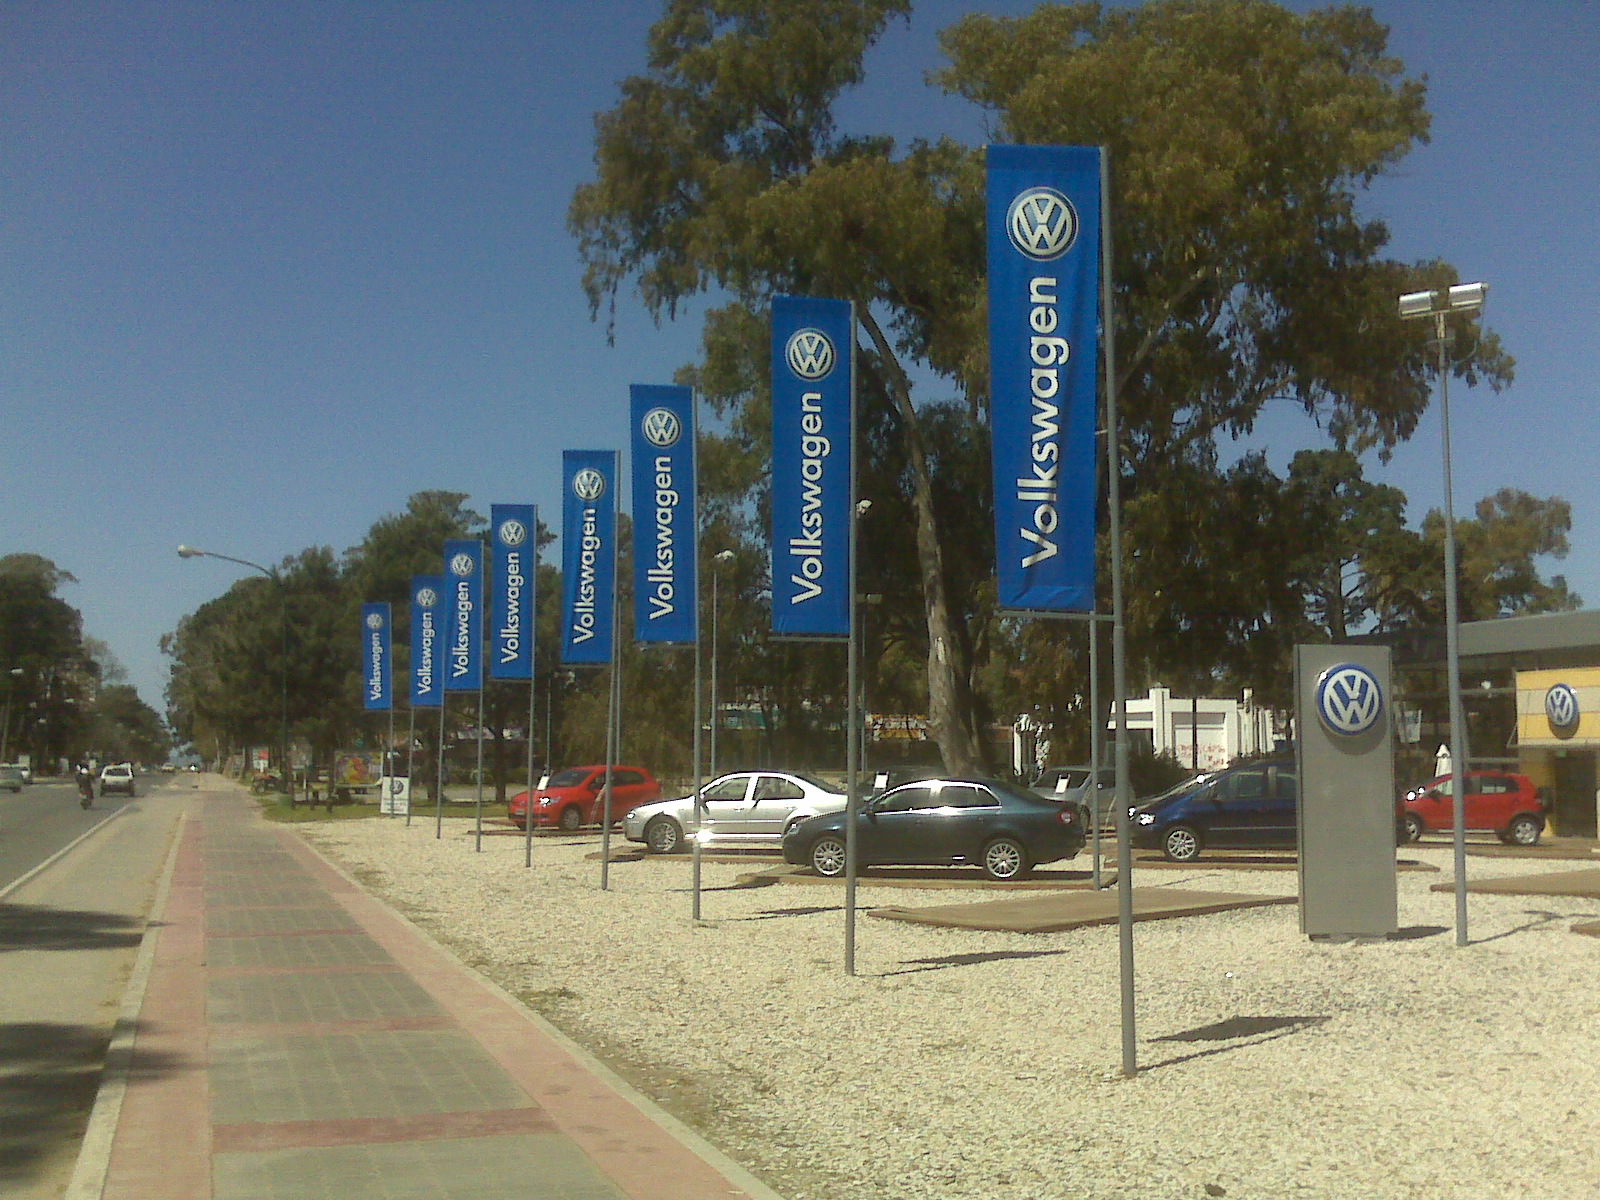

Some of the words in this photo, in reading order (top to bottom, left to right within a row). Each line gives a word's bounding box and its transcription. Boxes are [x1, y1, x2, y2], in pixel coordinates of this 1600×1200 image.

[1017, 276, 1070, 569] Volkswagen
[647, 456, 679, 620] Volkswagen
[789, 392, 831, 605] Volkswagen
[452, 581, 474, 678] Volkswagen
[500, 552, 525, 664] Volkswagen
[572, 508, 601, 644] Volkswagen
[369, 632, 384, 701] Volkswagen
[417, 612, 436, 695] Volkswagen
